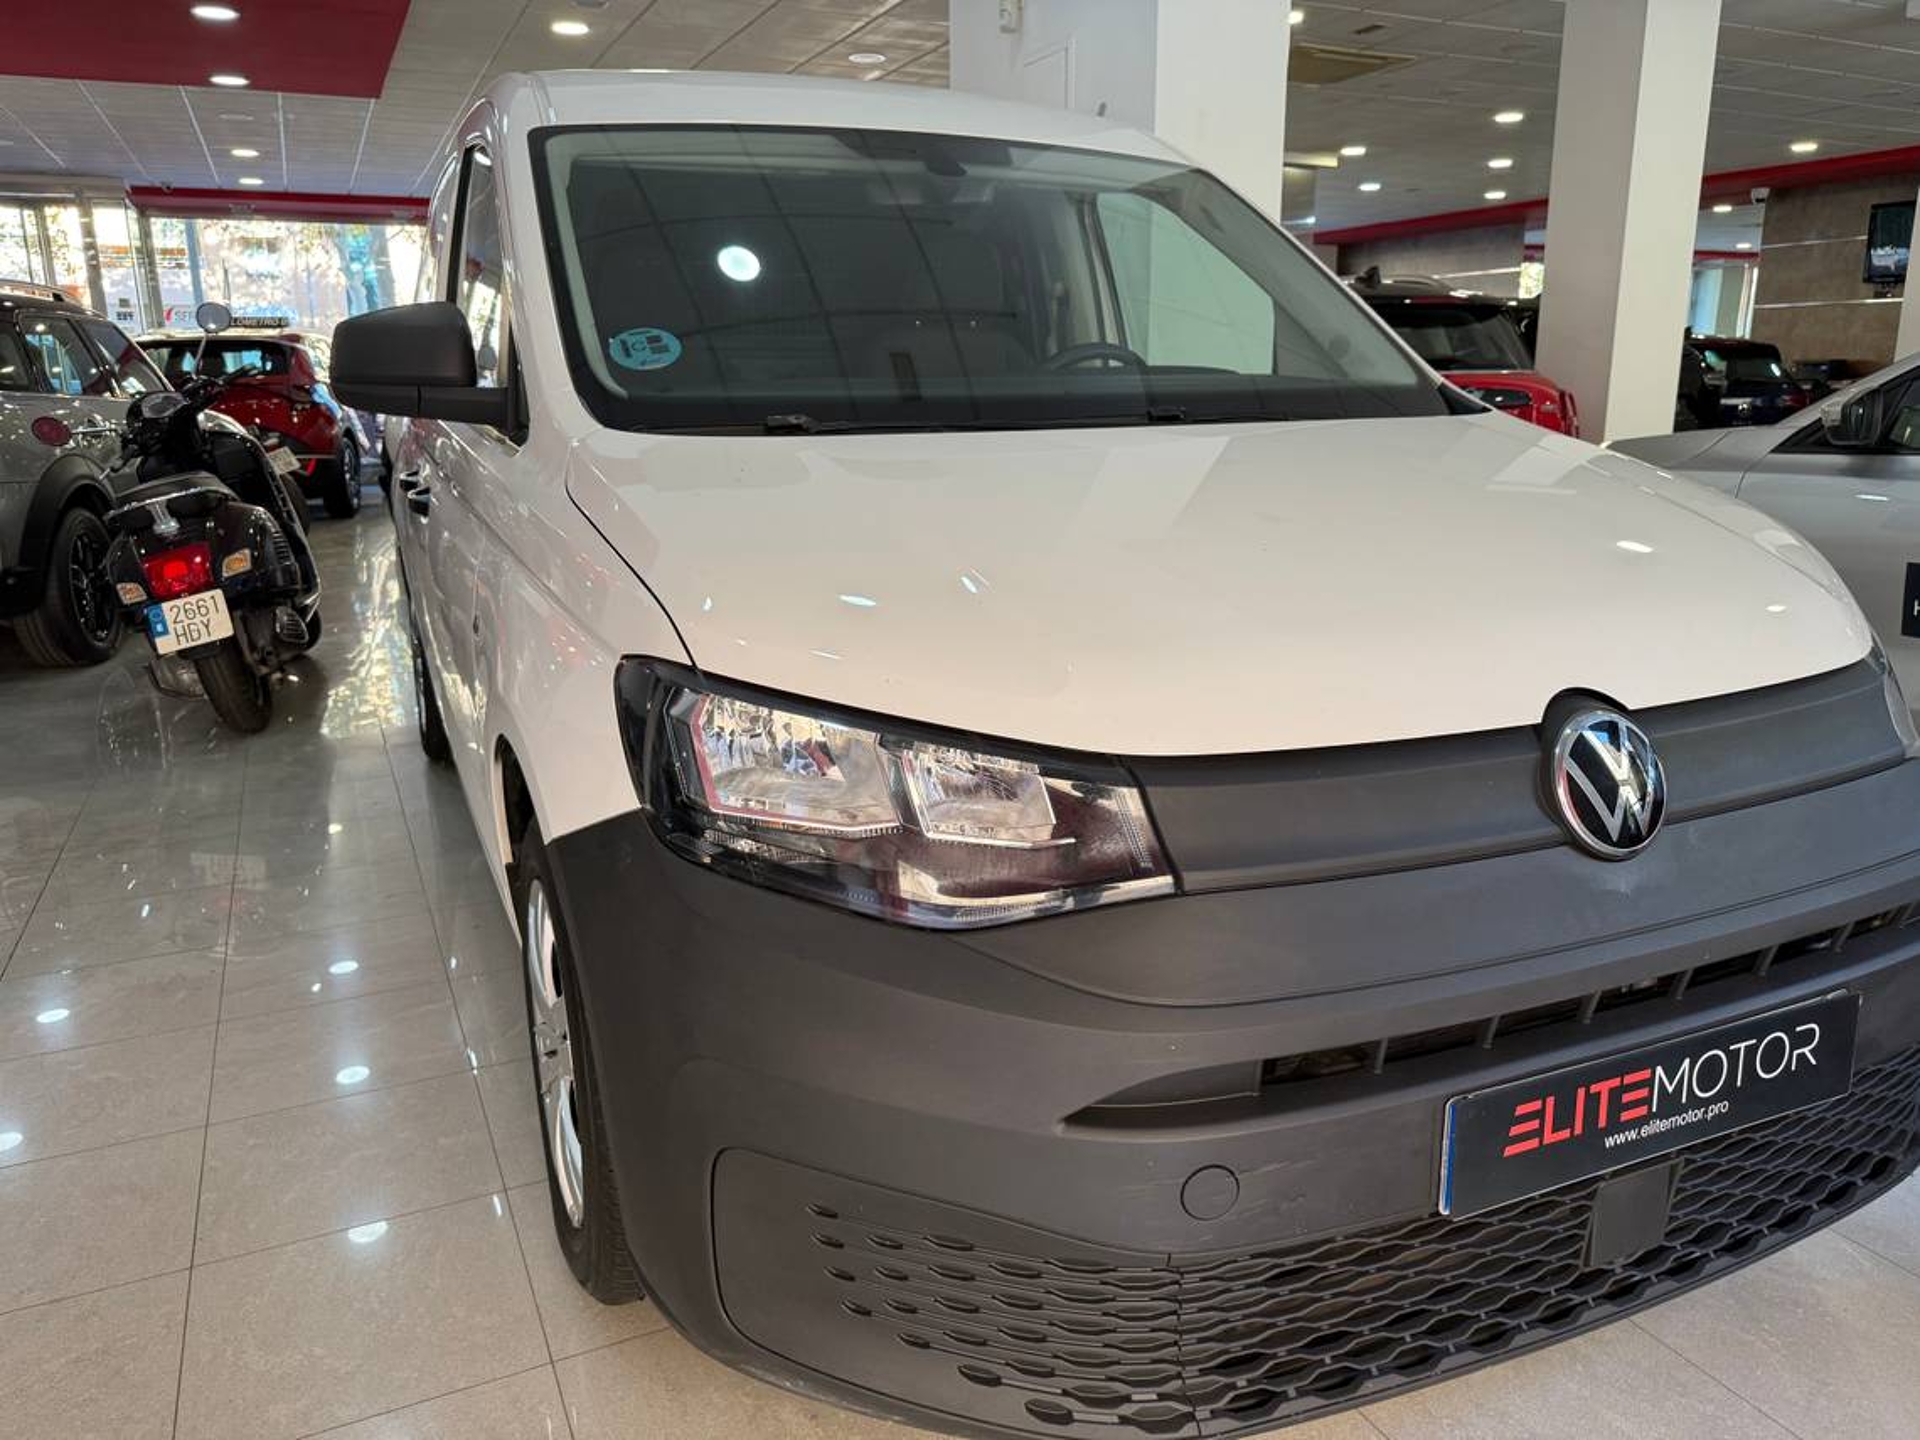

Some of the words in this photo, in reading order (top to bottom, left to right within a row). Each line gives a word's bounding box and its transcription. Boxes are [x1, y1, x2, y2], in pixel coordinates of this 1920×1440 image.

[169, 595, 219, 623] 2661
[174, 617, 211, 645] HDY
[1560, 717, 1657, 846] VW
[1502, 1023, 1820, 1158] ELITEMOTOR
[1604, 1100, 1730, 1149] www.elitemotor.pro
